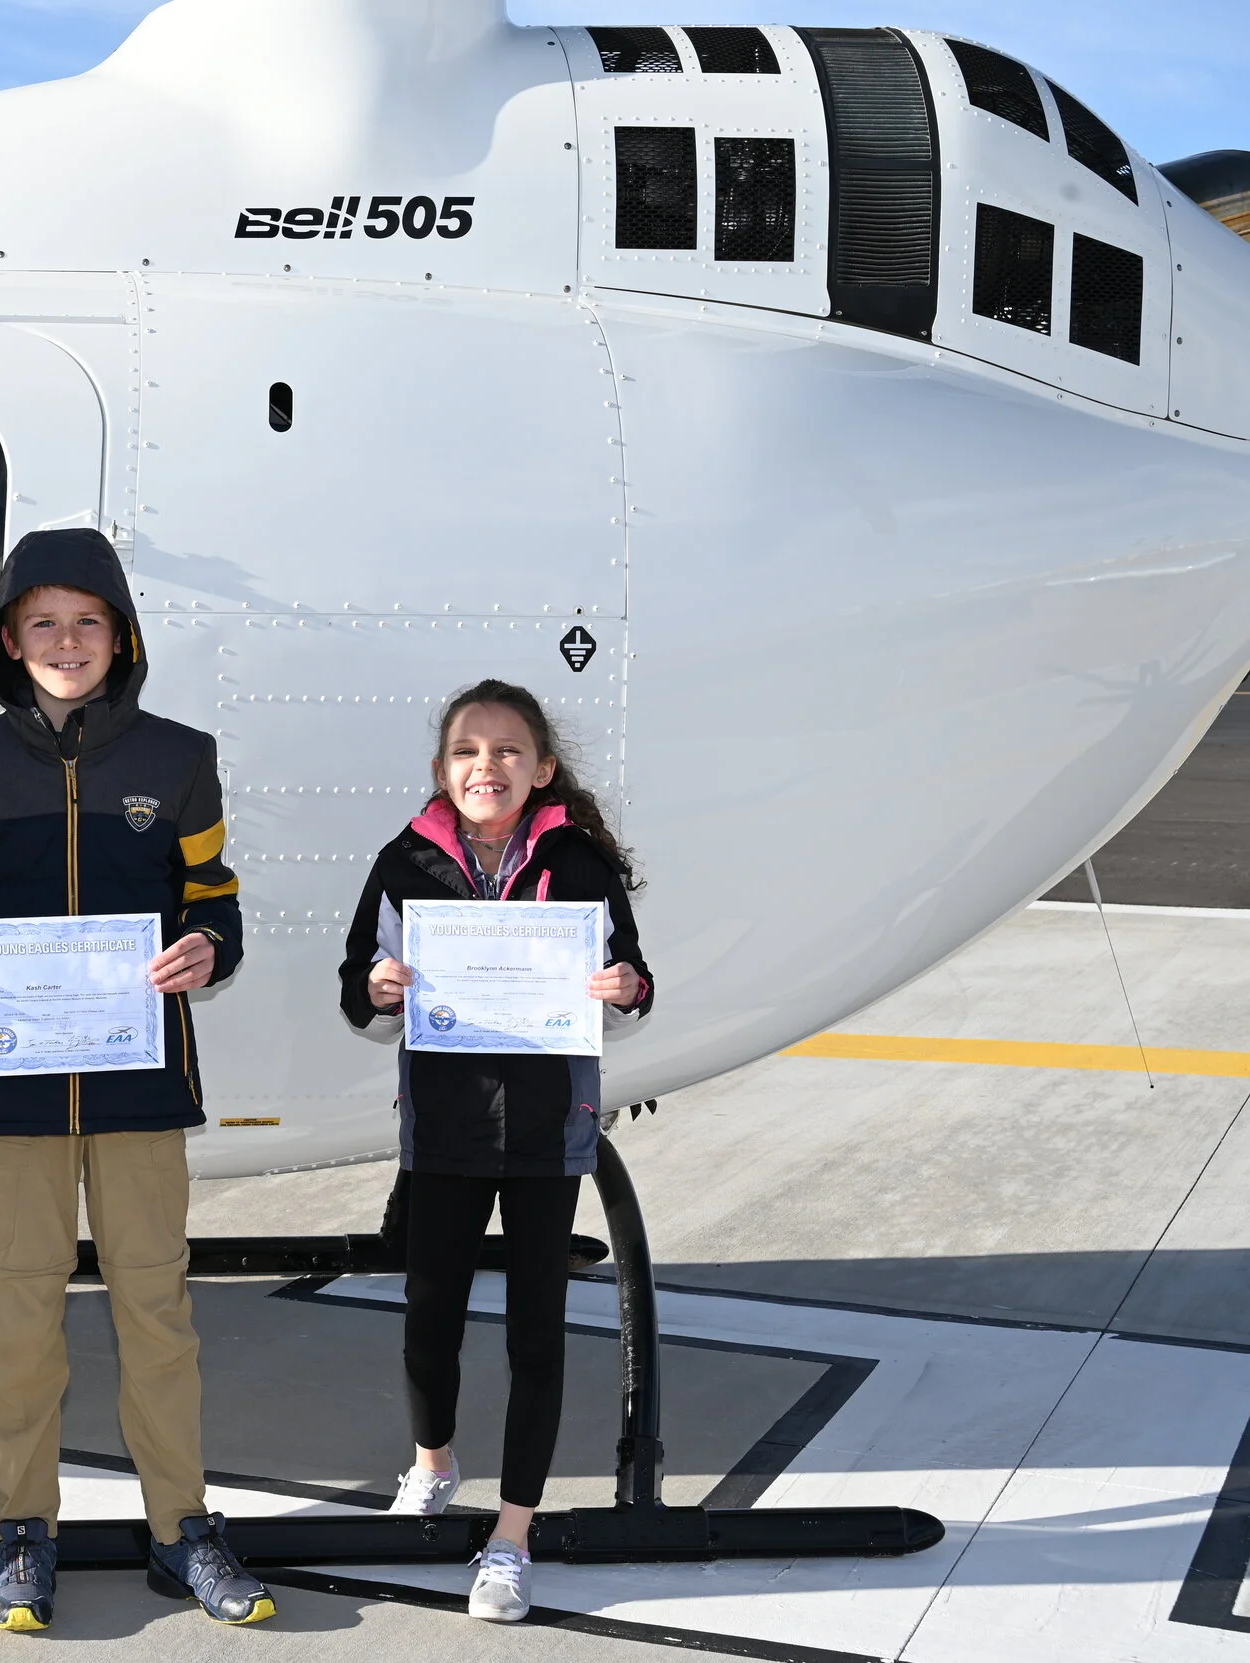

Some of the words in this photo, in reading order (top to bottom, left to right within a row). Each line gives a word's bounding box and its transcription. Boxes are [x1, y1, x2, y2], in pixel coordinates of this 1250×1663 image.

[234, 196, 361, 239] Bell
[363, 195, 475, 239] 505
[429, 924, 469, 936] YOUNG
[469, 924, 510, 937] EAGLES
[512, 925, 578, 938] CERTIFICATE
[28, 941, 69, 954] EAGLES
[71, 940, 135, 952] CERTIFICATE
[545, 1018, 571, 1027] EAA
[106, 1034, 132, 1043] EAA
